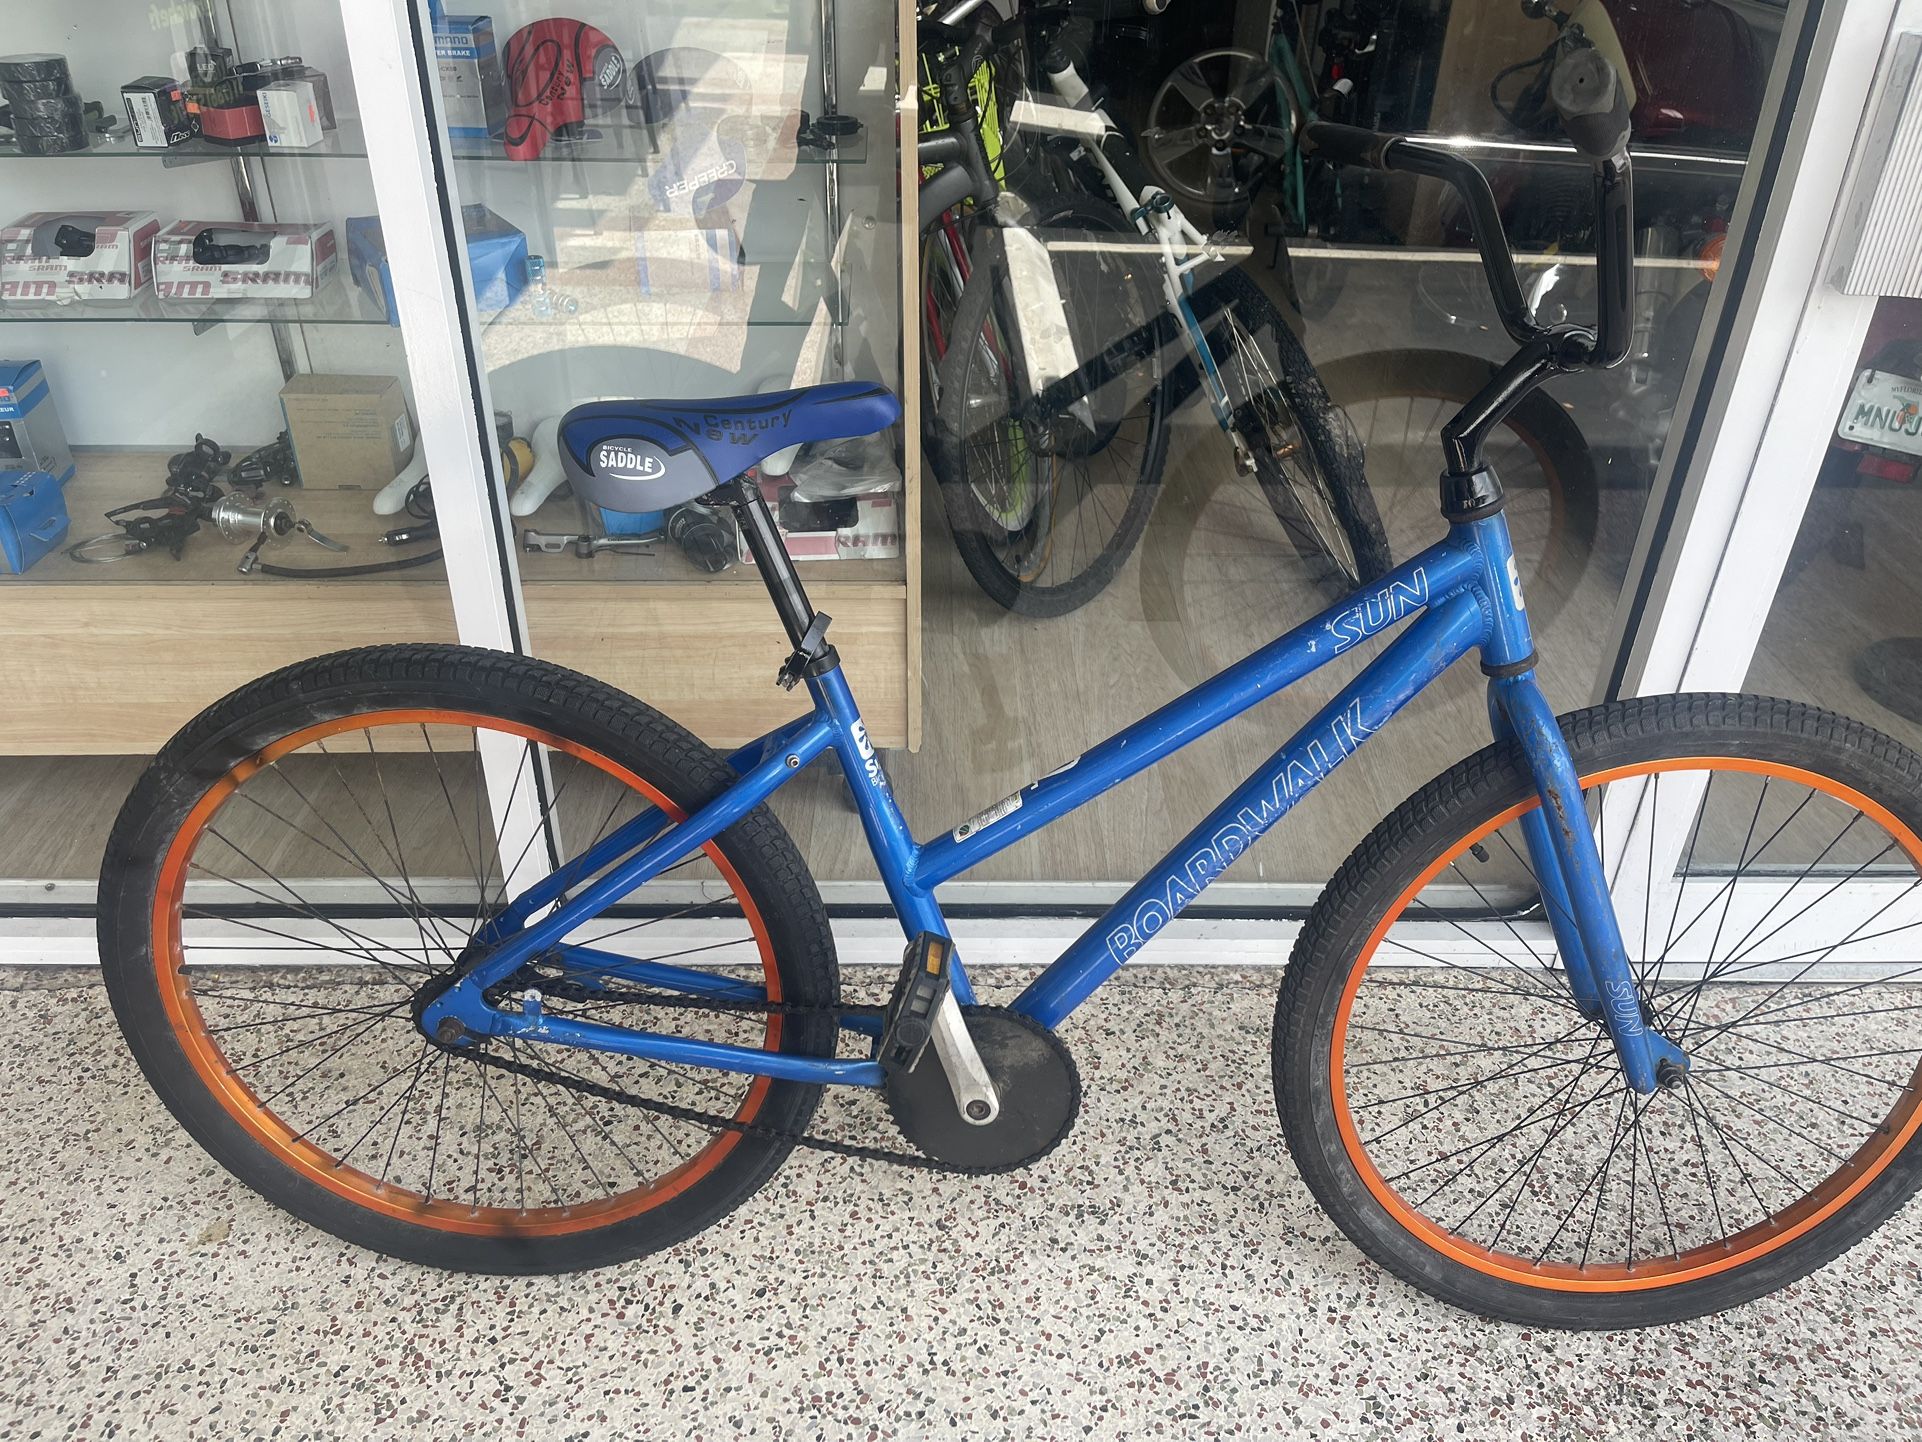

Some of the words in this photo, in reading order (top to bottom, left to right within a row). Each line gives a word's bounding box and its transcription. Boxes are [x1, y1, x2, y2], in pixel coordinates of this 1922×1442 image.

[600, 55, 621, 90] SADDLE
[28, 264, 68, 272] SRAM
[220, 270, 312, 285] SRAM
[703, 409, 794, 431] Century
[1853, 403, 1922, 436] MNUJ
[600, 450, 654, 473] SADDLE
[602, 445, 633, 453] BICYCLE
[1330, 567, 1430, 653] SUN
[1106, 697, 1380, 967] BOARDWALK
[1605, 980, 1644, 1037] SUN
